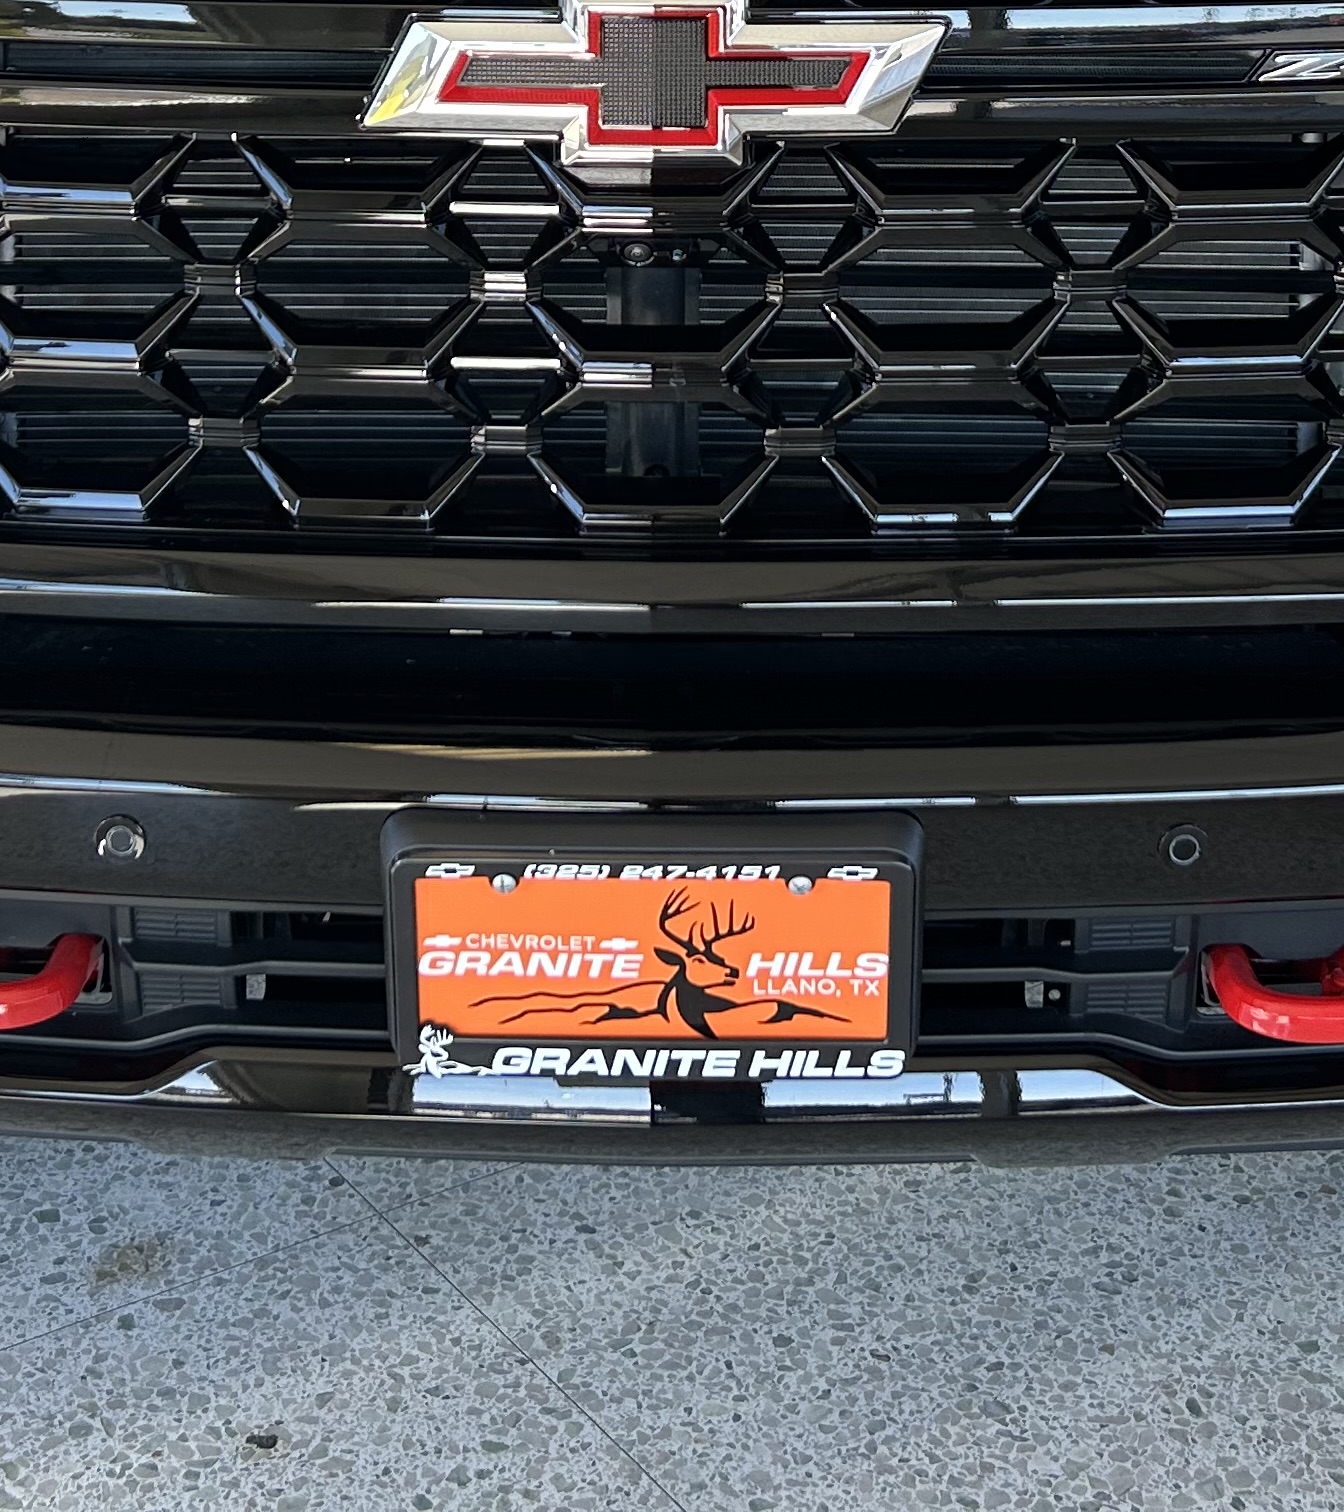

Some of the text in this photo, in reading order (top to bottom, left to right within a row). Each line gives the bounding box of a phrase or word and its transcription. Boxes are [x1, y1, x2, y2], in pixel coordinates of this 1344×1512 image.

[523, 863, 781, 881] (325) 247-4151
[465, 933, 596, 950] CHEVROLET
[418, 951, 890, 978] GRANITE HILLS
[753, 978, 880, 997] LLANO, TX
[492, 1048, 906, 1078] GRANITE HILLS
